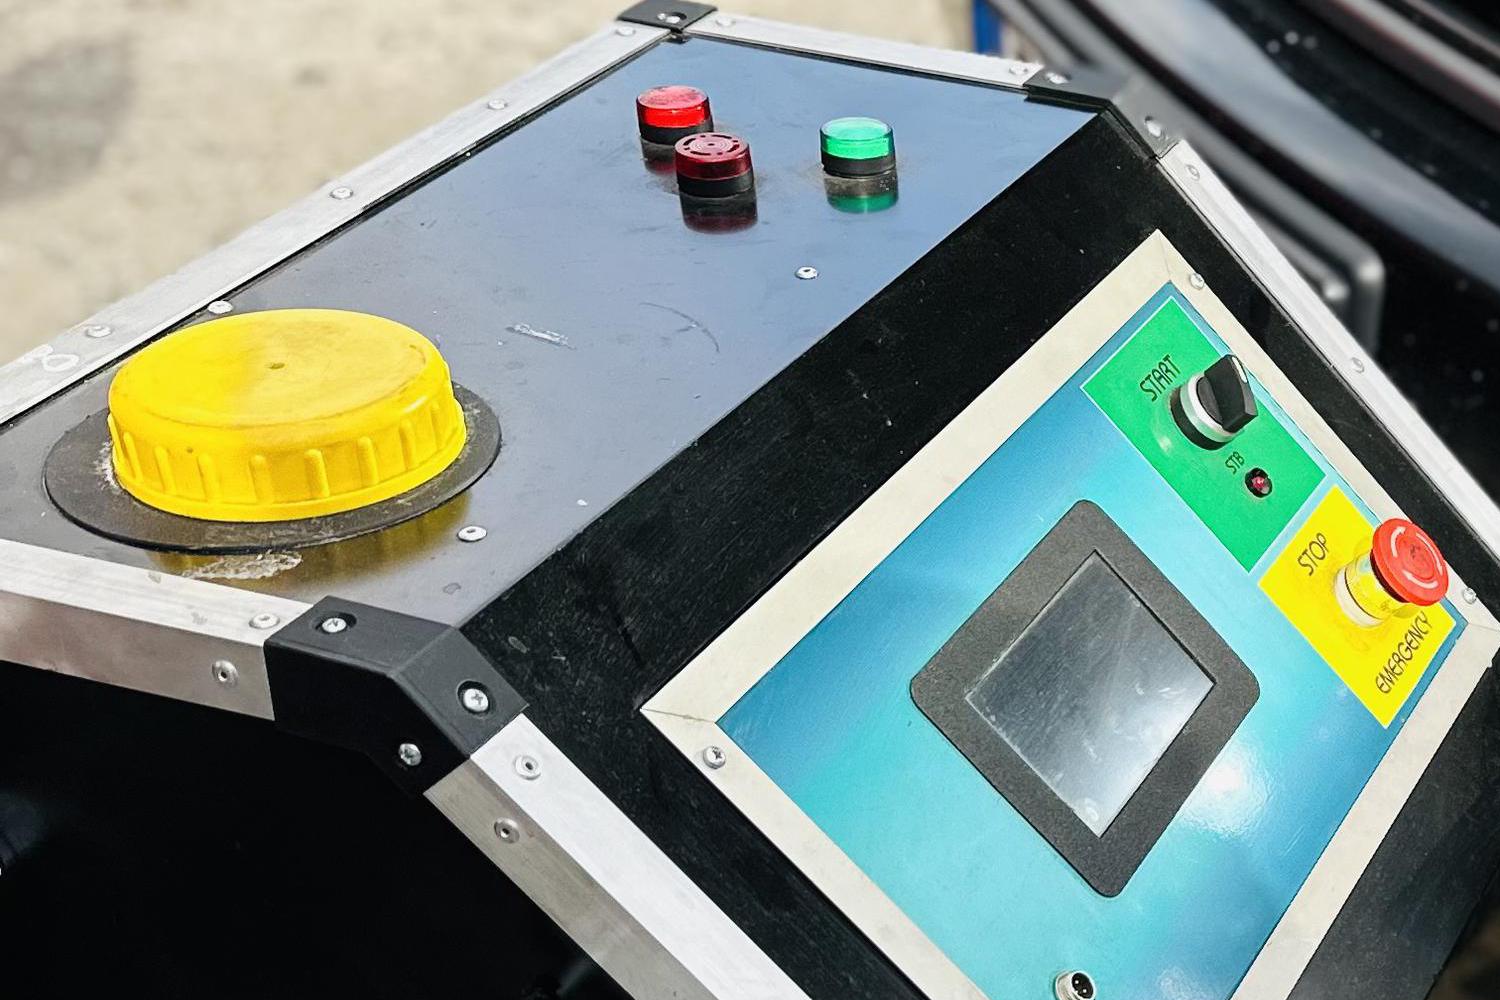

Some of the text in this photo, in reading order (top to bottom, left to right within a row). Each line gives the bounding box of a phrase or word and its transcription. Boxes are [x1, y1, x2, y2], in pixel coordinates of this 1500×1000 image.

[1140, 354, 1181, 402] START
[1225, 451, 1245, 475] STB
[1297, 532, 1330, 577] STOP
[1375, 611, 1433, 694] EMERGENCY
